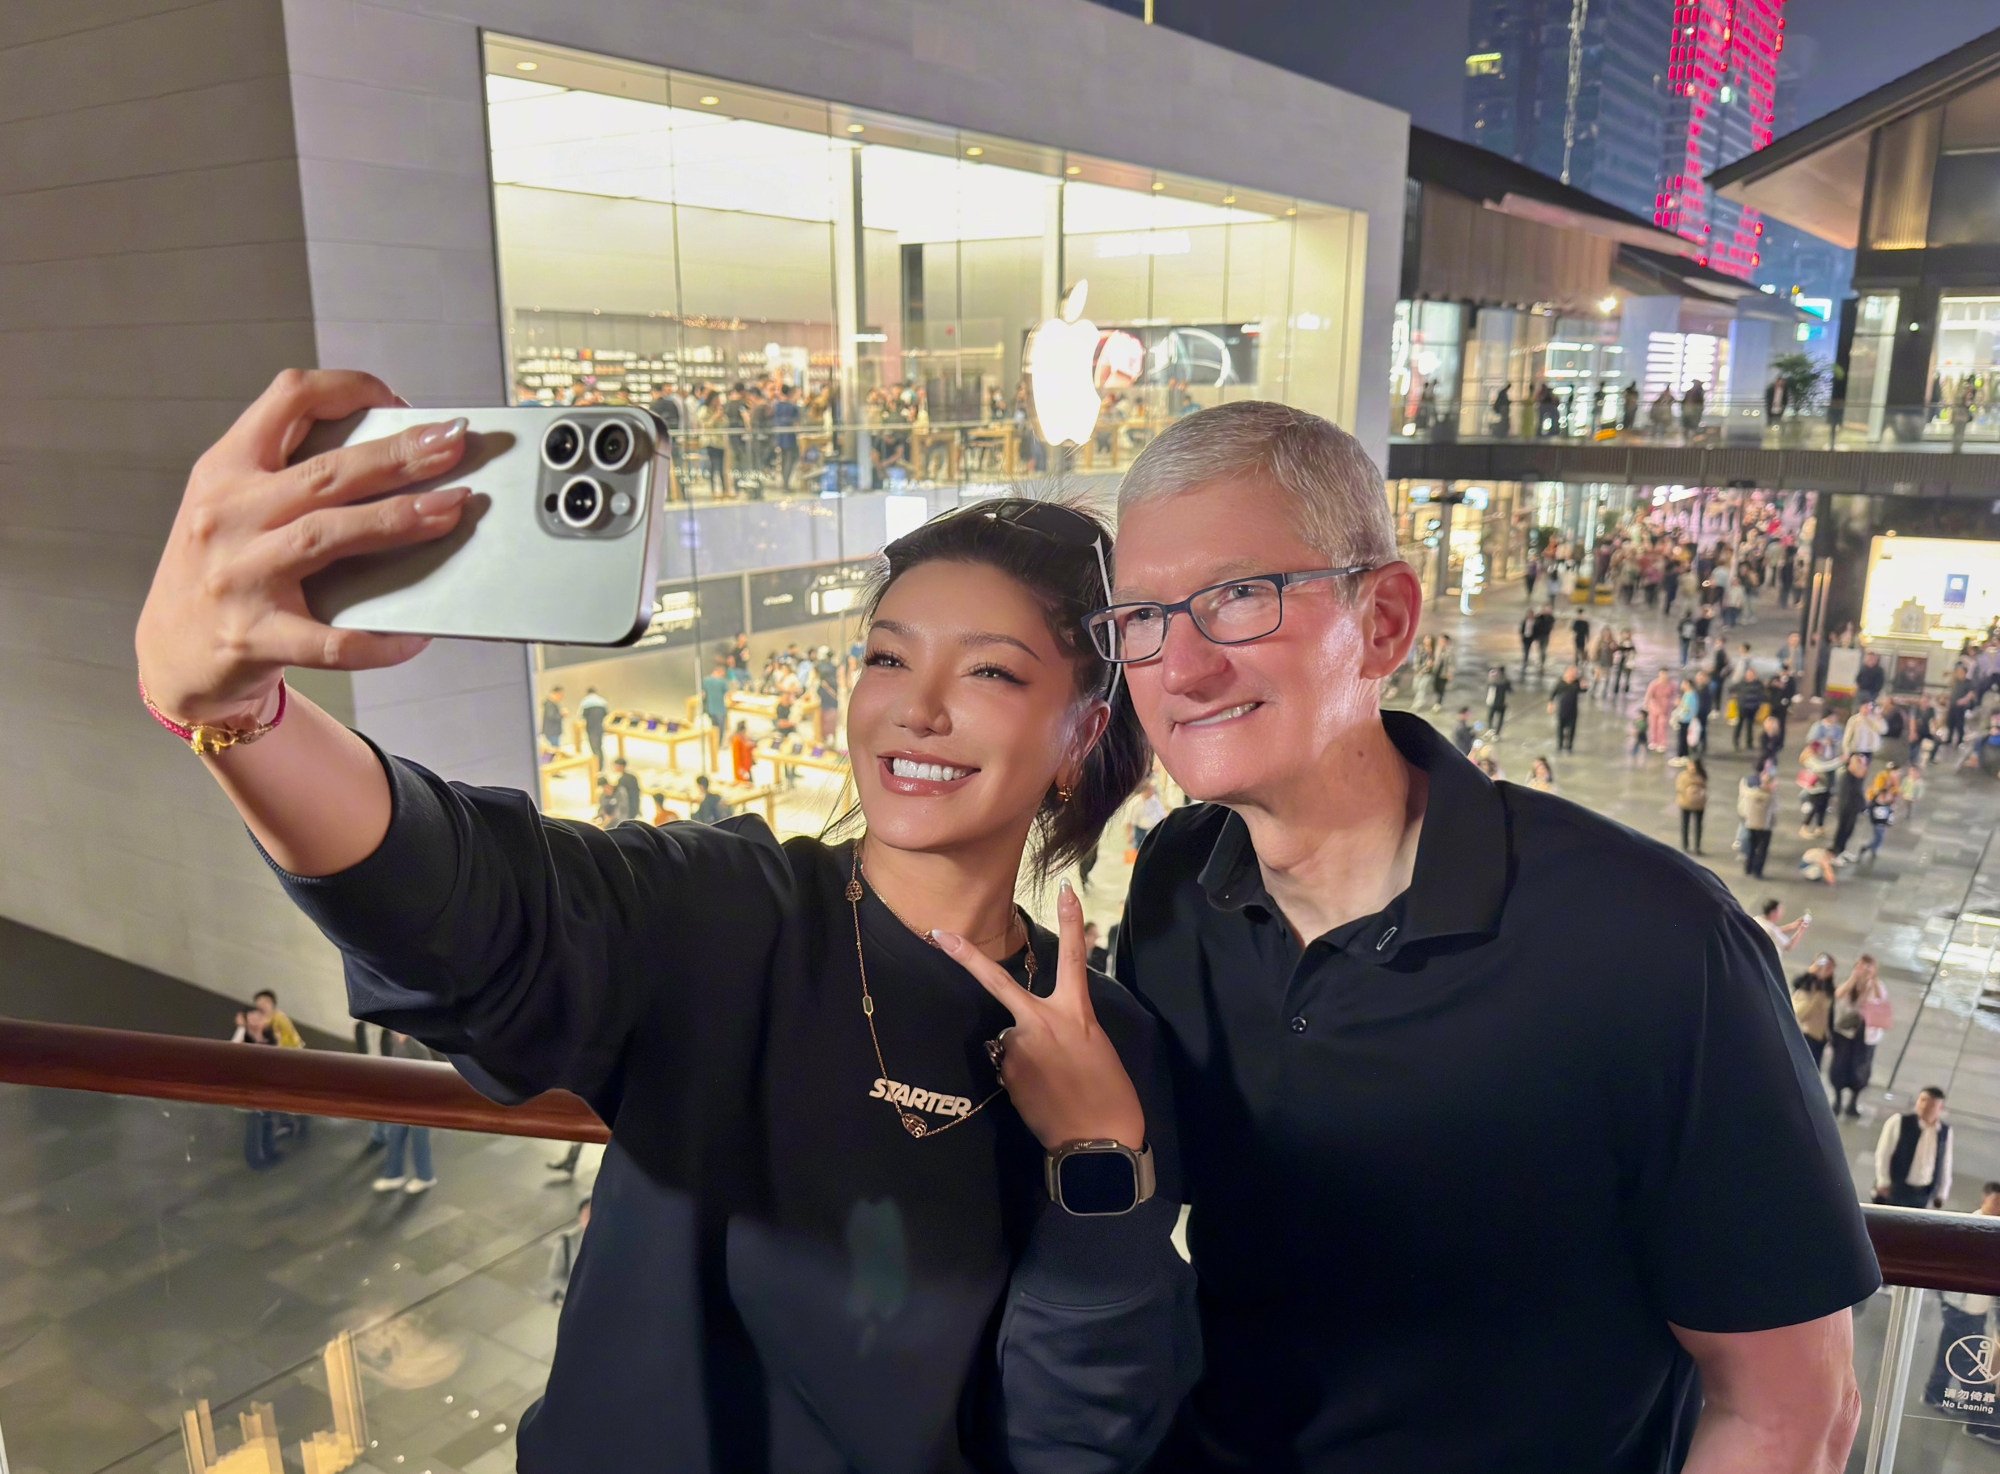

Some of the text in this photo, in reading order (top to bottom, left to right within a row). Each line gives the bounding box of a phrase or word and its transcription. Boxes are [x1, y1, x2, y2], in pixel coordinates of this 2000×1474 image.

[869, 1078, 972, 1117] STARTER
[1941, 1400, 1994, 1414] No Leaning
